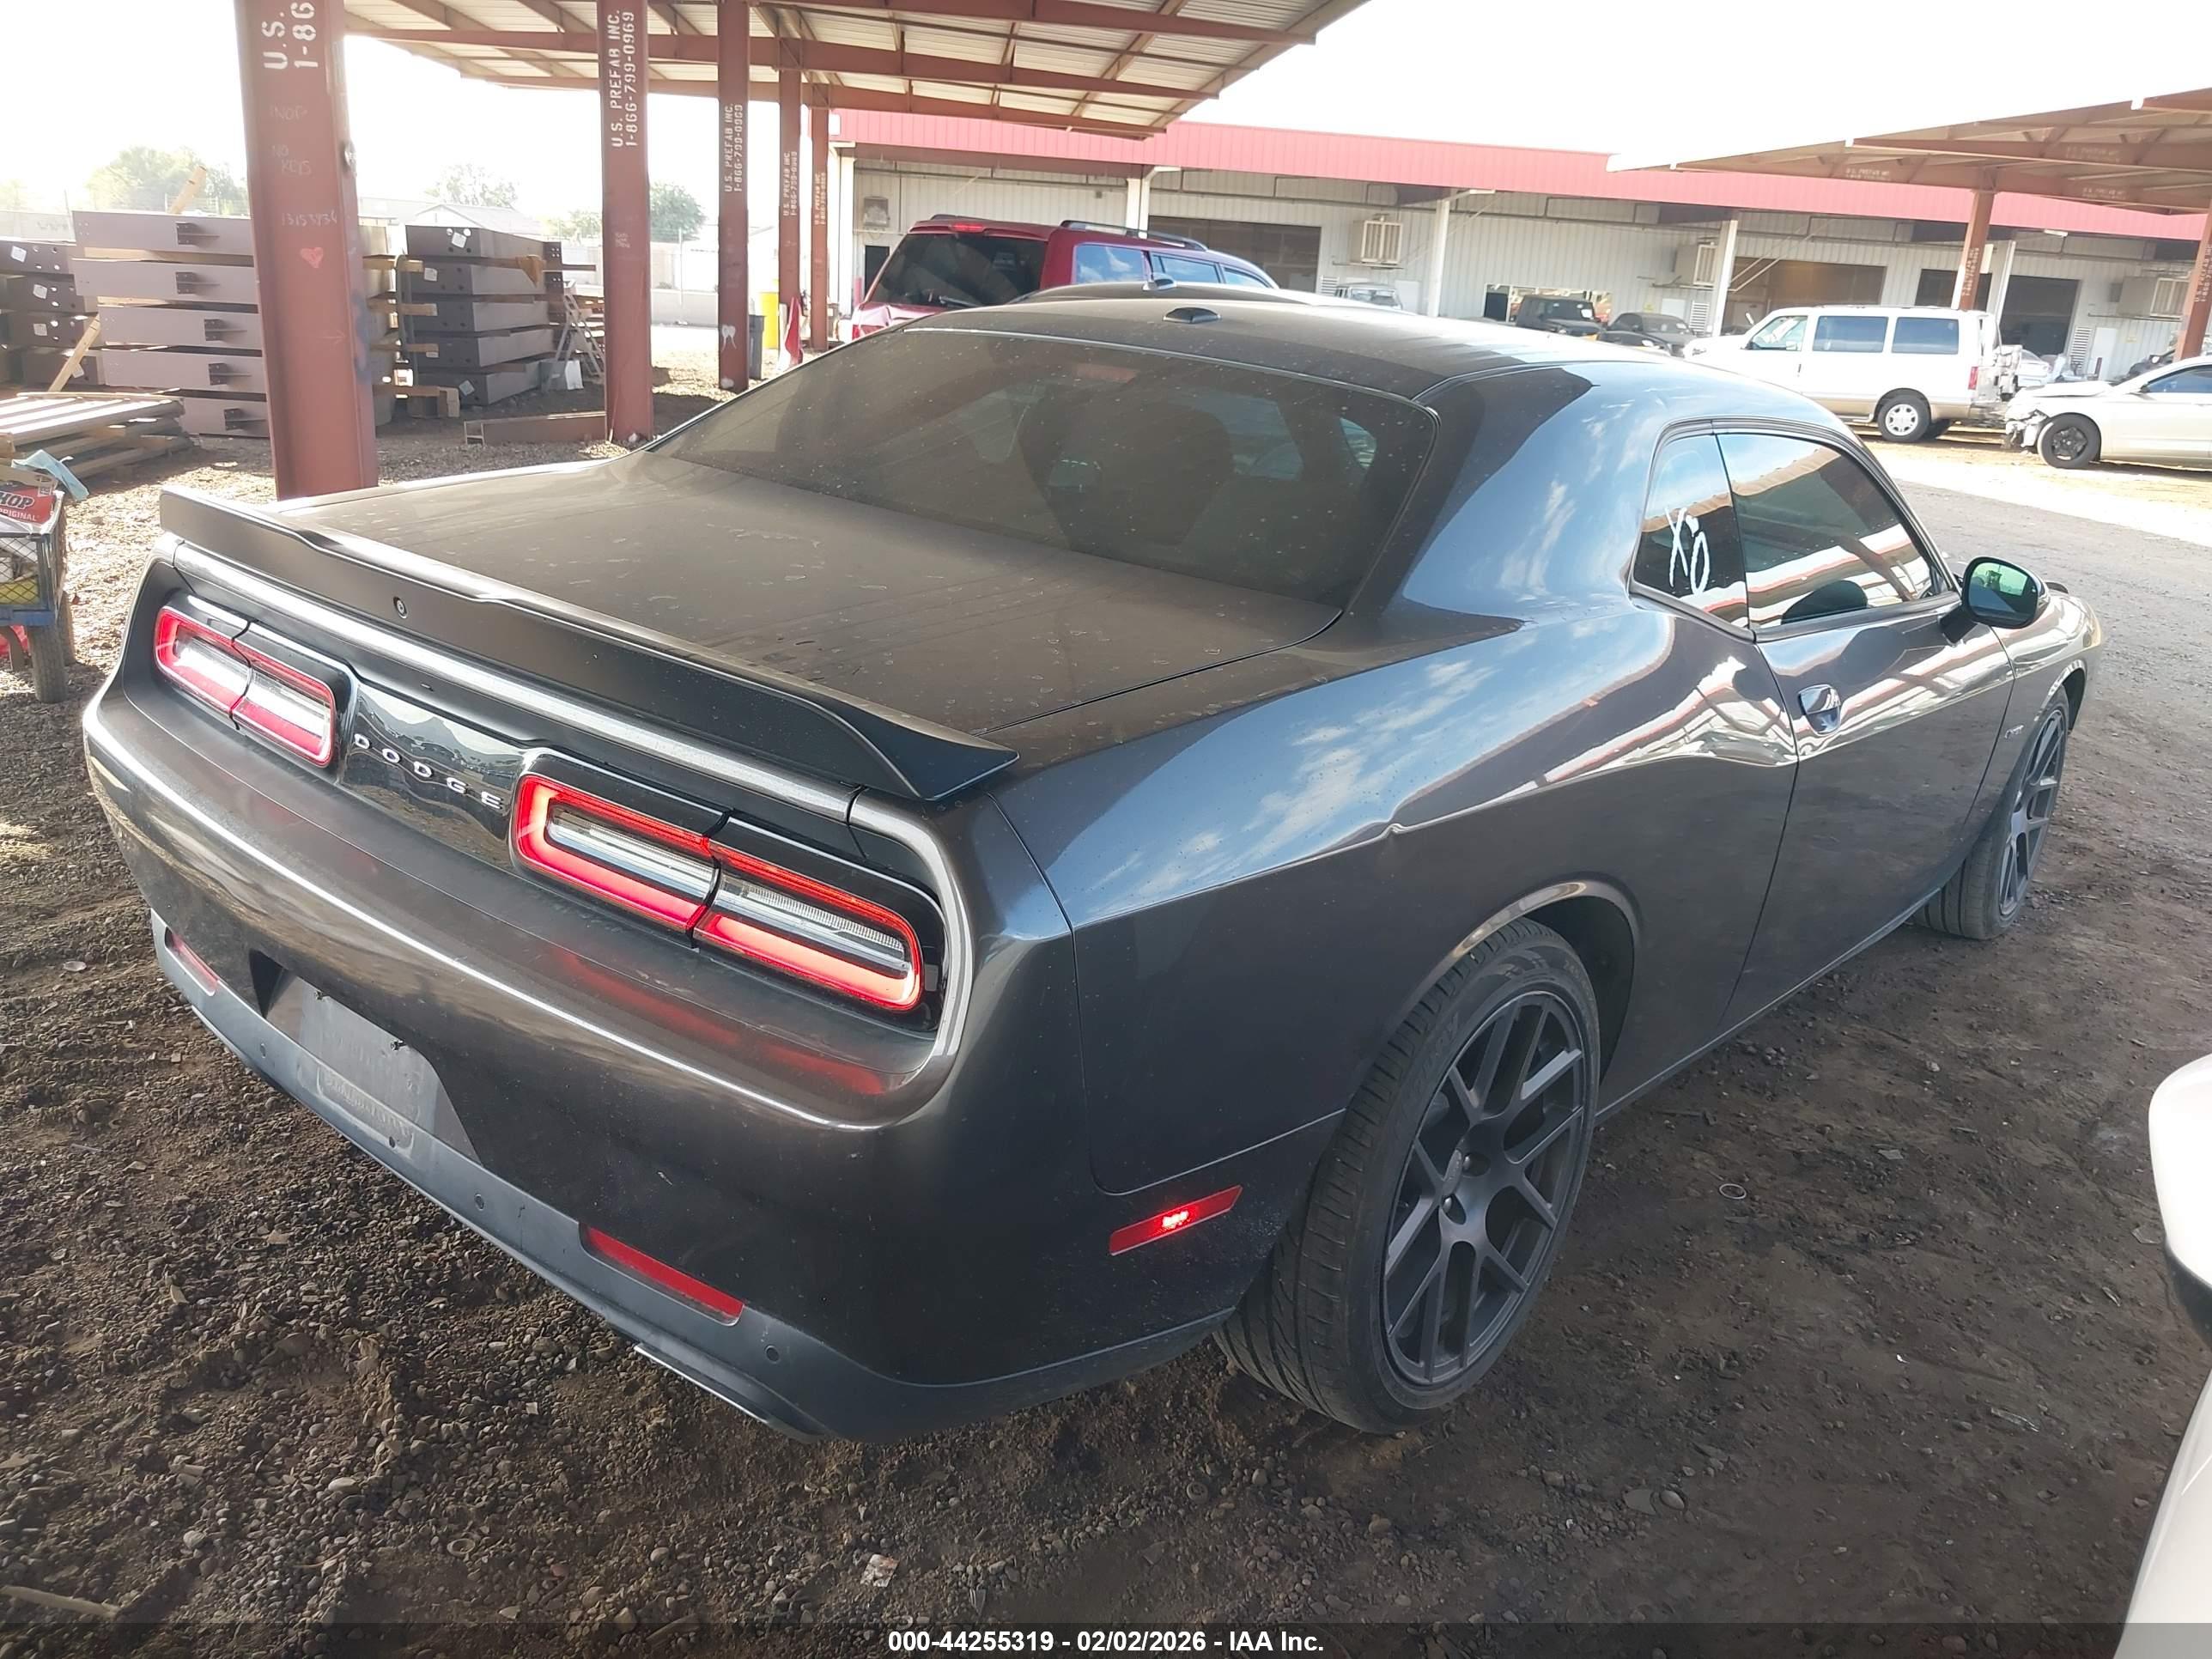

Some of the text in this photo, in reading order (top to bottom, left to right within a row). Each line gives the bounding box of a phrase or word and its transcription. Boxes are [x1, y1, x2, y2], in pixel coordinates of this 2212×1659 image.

[261, 11, 289, 70] U.S.
[607, 9, 623, 148] U.S. PREFAB INC.
[622, 11, 638, 147] 1-866-799-0969
[724, 127, 733, 167] PREFAB
[733, 104, 743, 192] 1-866-799-0969
[354, 733, 503, 810] DODGE
